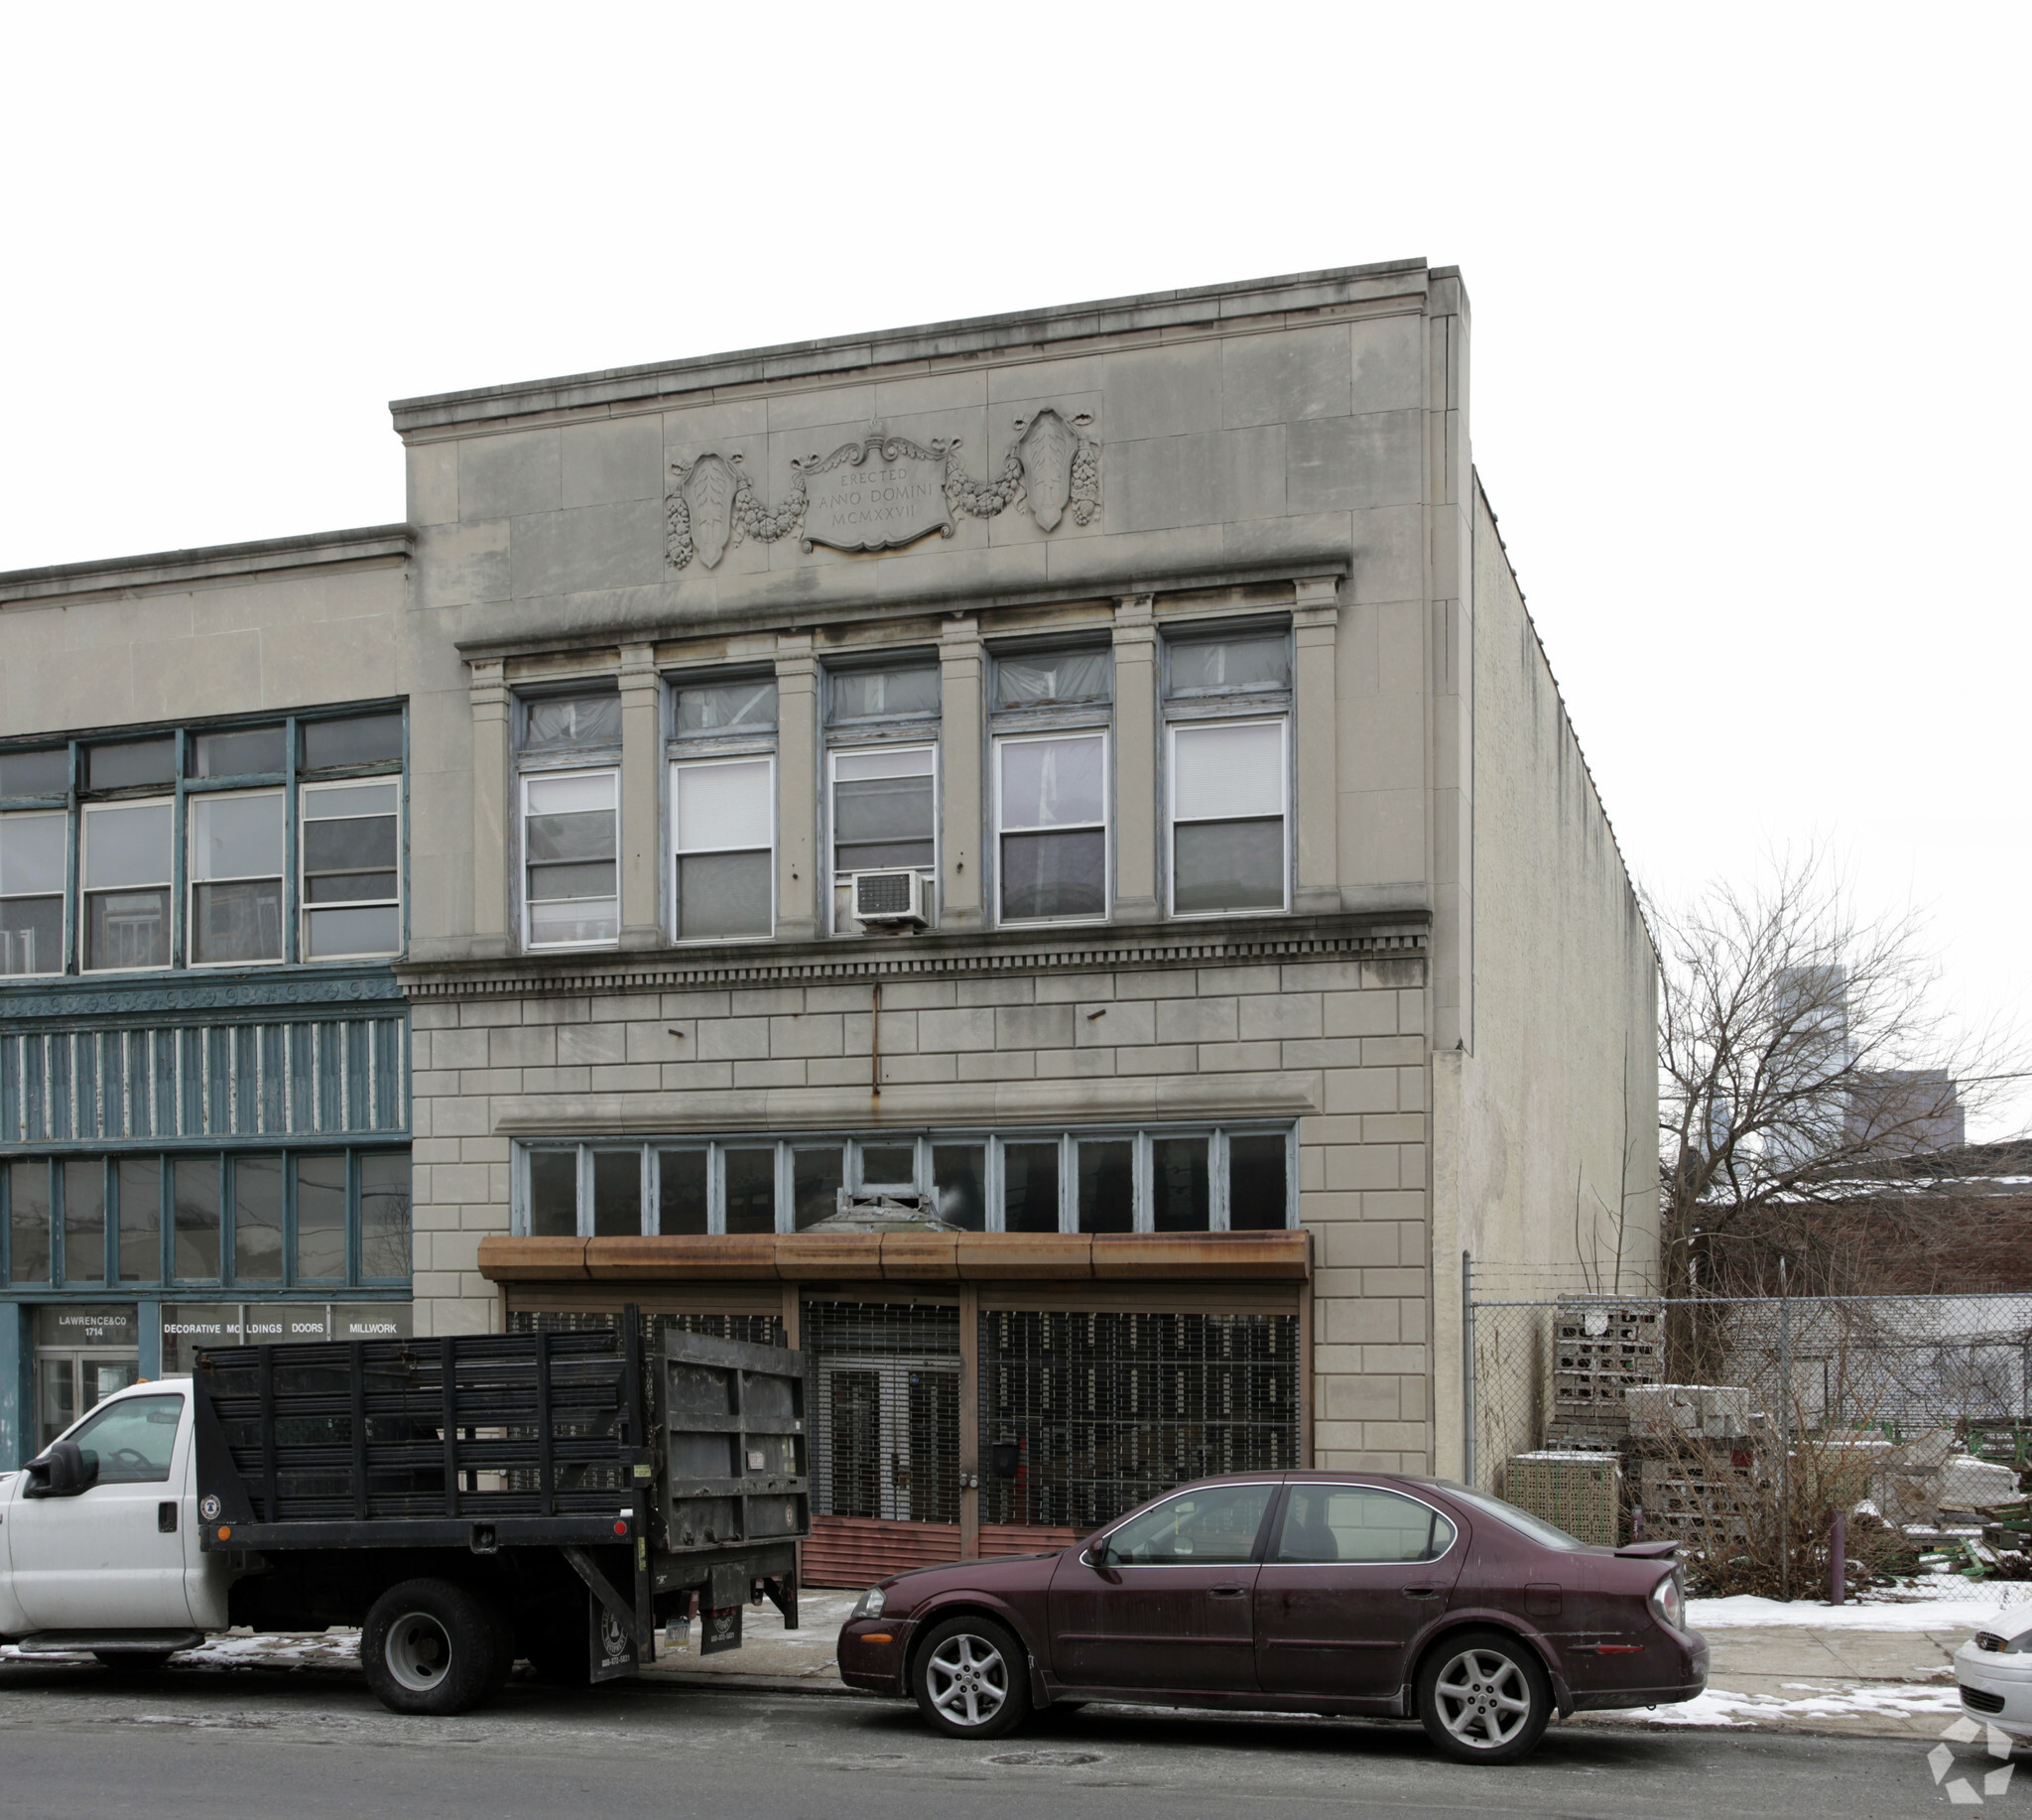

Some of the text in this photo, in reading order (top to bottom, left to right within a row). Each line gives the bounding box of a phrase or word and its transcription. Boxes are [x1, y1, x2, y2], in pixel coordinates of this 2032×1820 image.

[841, 468, 907, 486] ERECTED
[820, 484, 932, 508] ANNO DOMINI
[832, 505, 915, 526] MCMXXVII
[59, 1316, 127, 1326] LAWRENCE&CO
[85, 1327, 103, 1337] 1714
[164, 1324, 221, 1334] DECORATIVE
[292, 1323, 324, 1333] DOORS
[349, 1324, 397, 1334] MILLWORK
